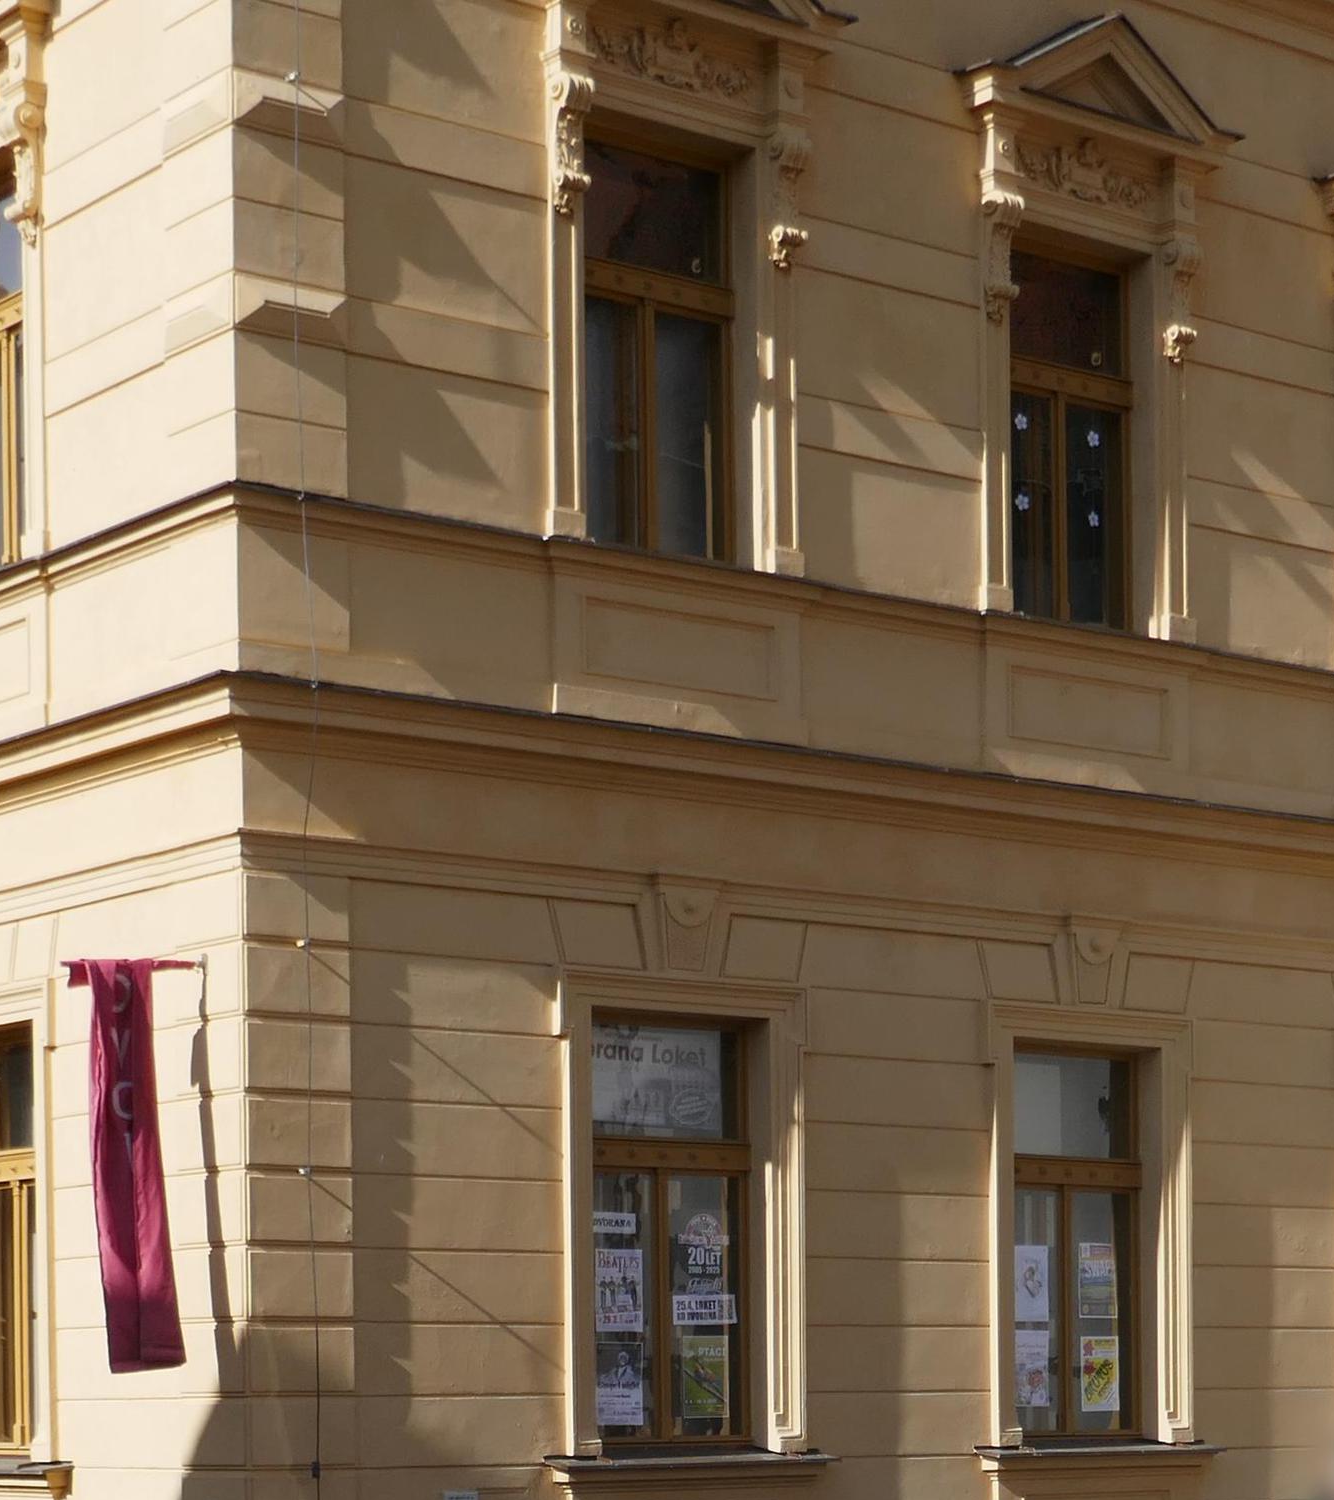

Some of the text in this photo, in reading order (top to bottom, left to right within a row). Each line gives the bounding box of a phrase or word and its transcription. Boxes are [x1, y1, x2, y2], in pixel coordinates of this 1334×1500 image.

[651, 1043, 708, 1066] Loket
[597, 1251, 640, 1273] BEATLES
[688, 1247, 722, 1266] 20 LET
[695, 1300, 716, 1310] LOKET
